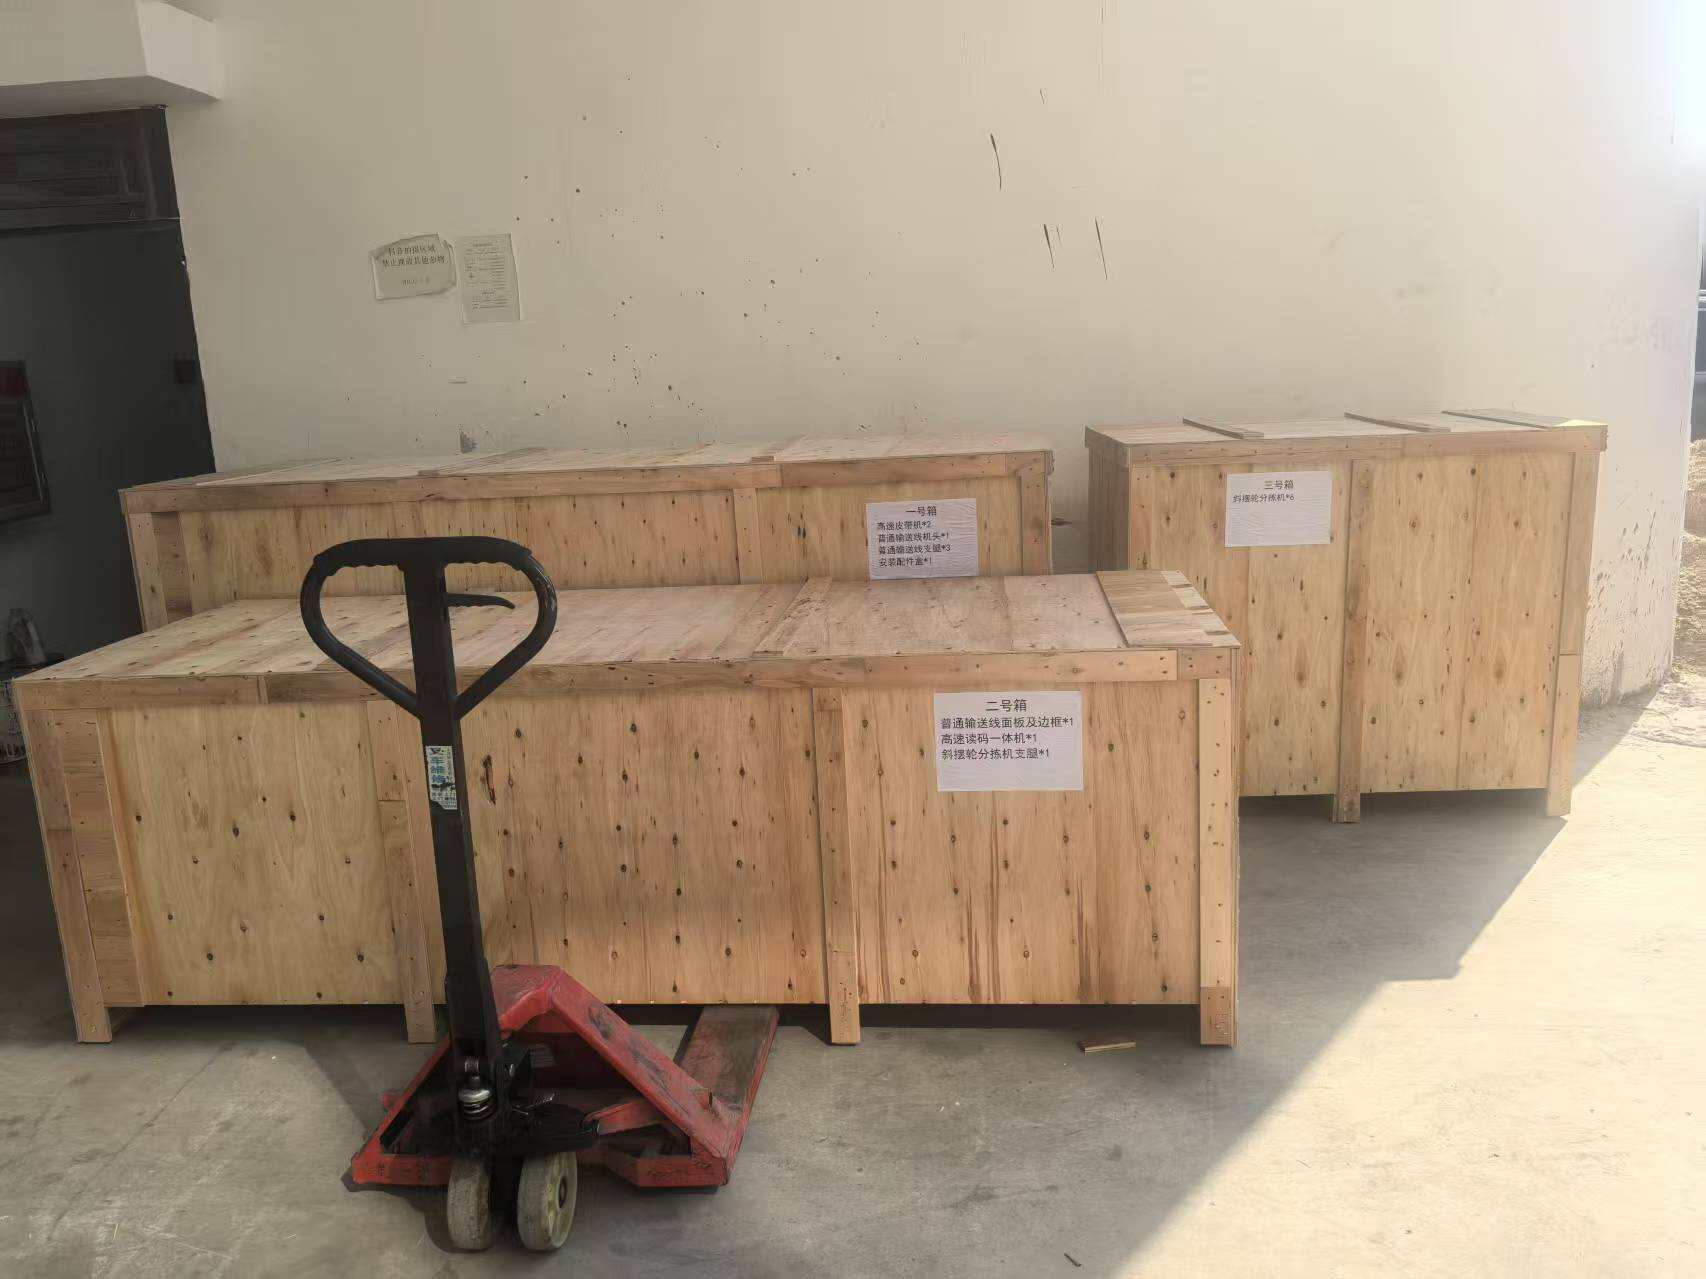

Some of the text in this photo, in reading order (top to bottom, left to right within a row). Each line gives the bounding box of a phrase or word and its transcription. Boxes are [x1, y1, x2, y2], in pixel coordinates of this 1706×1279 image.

[1264, 479, 1294, 490] 三号箱
[905, 505, 937, 517] 一号箱
[986, 698, 1027, 713] 二号箱
